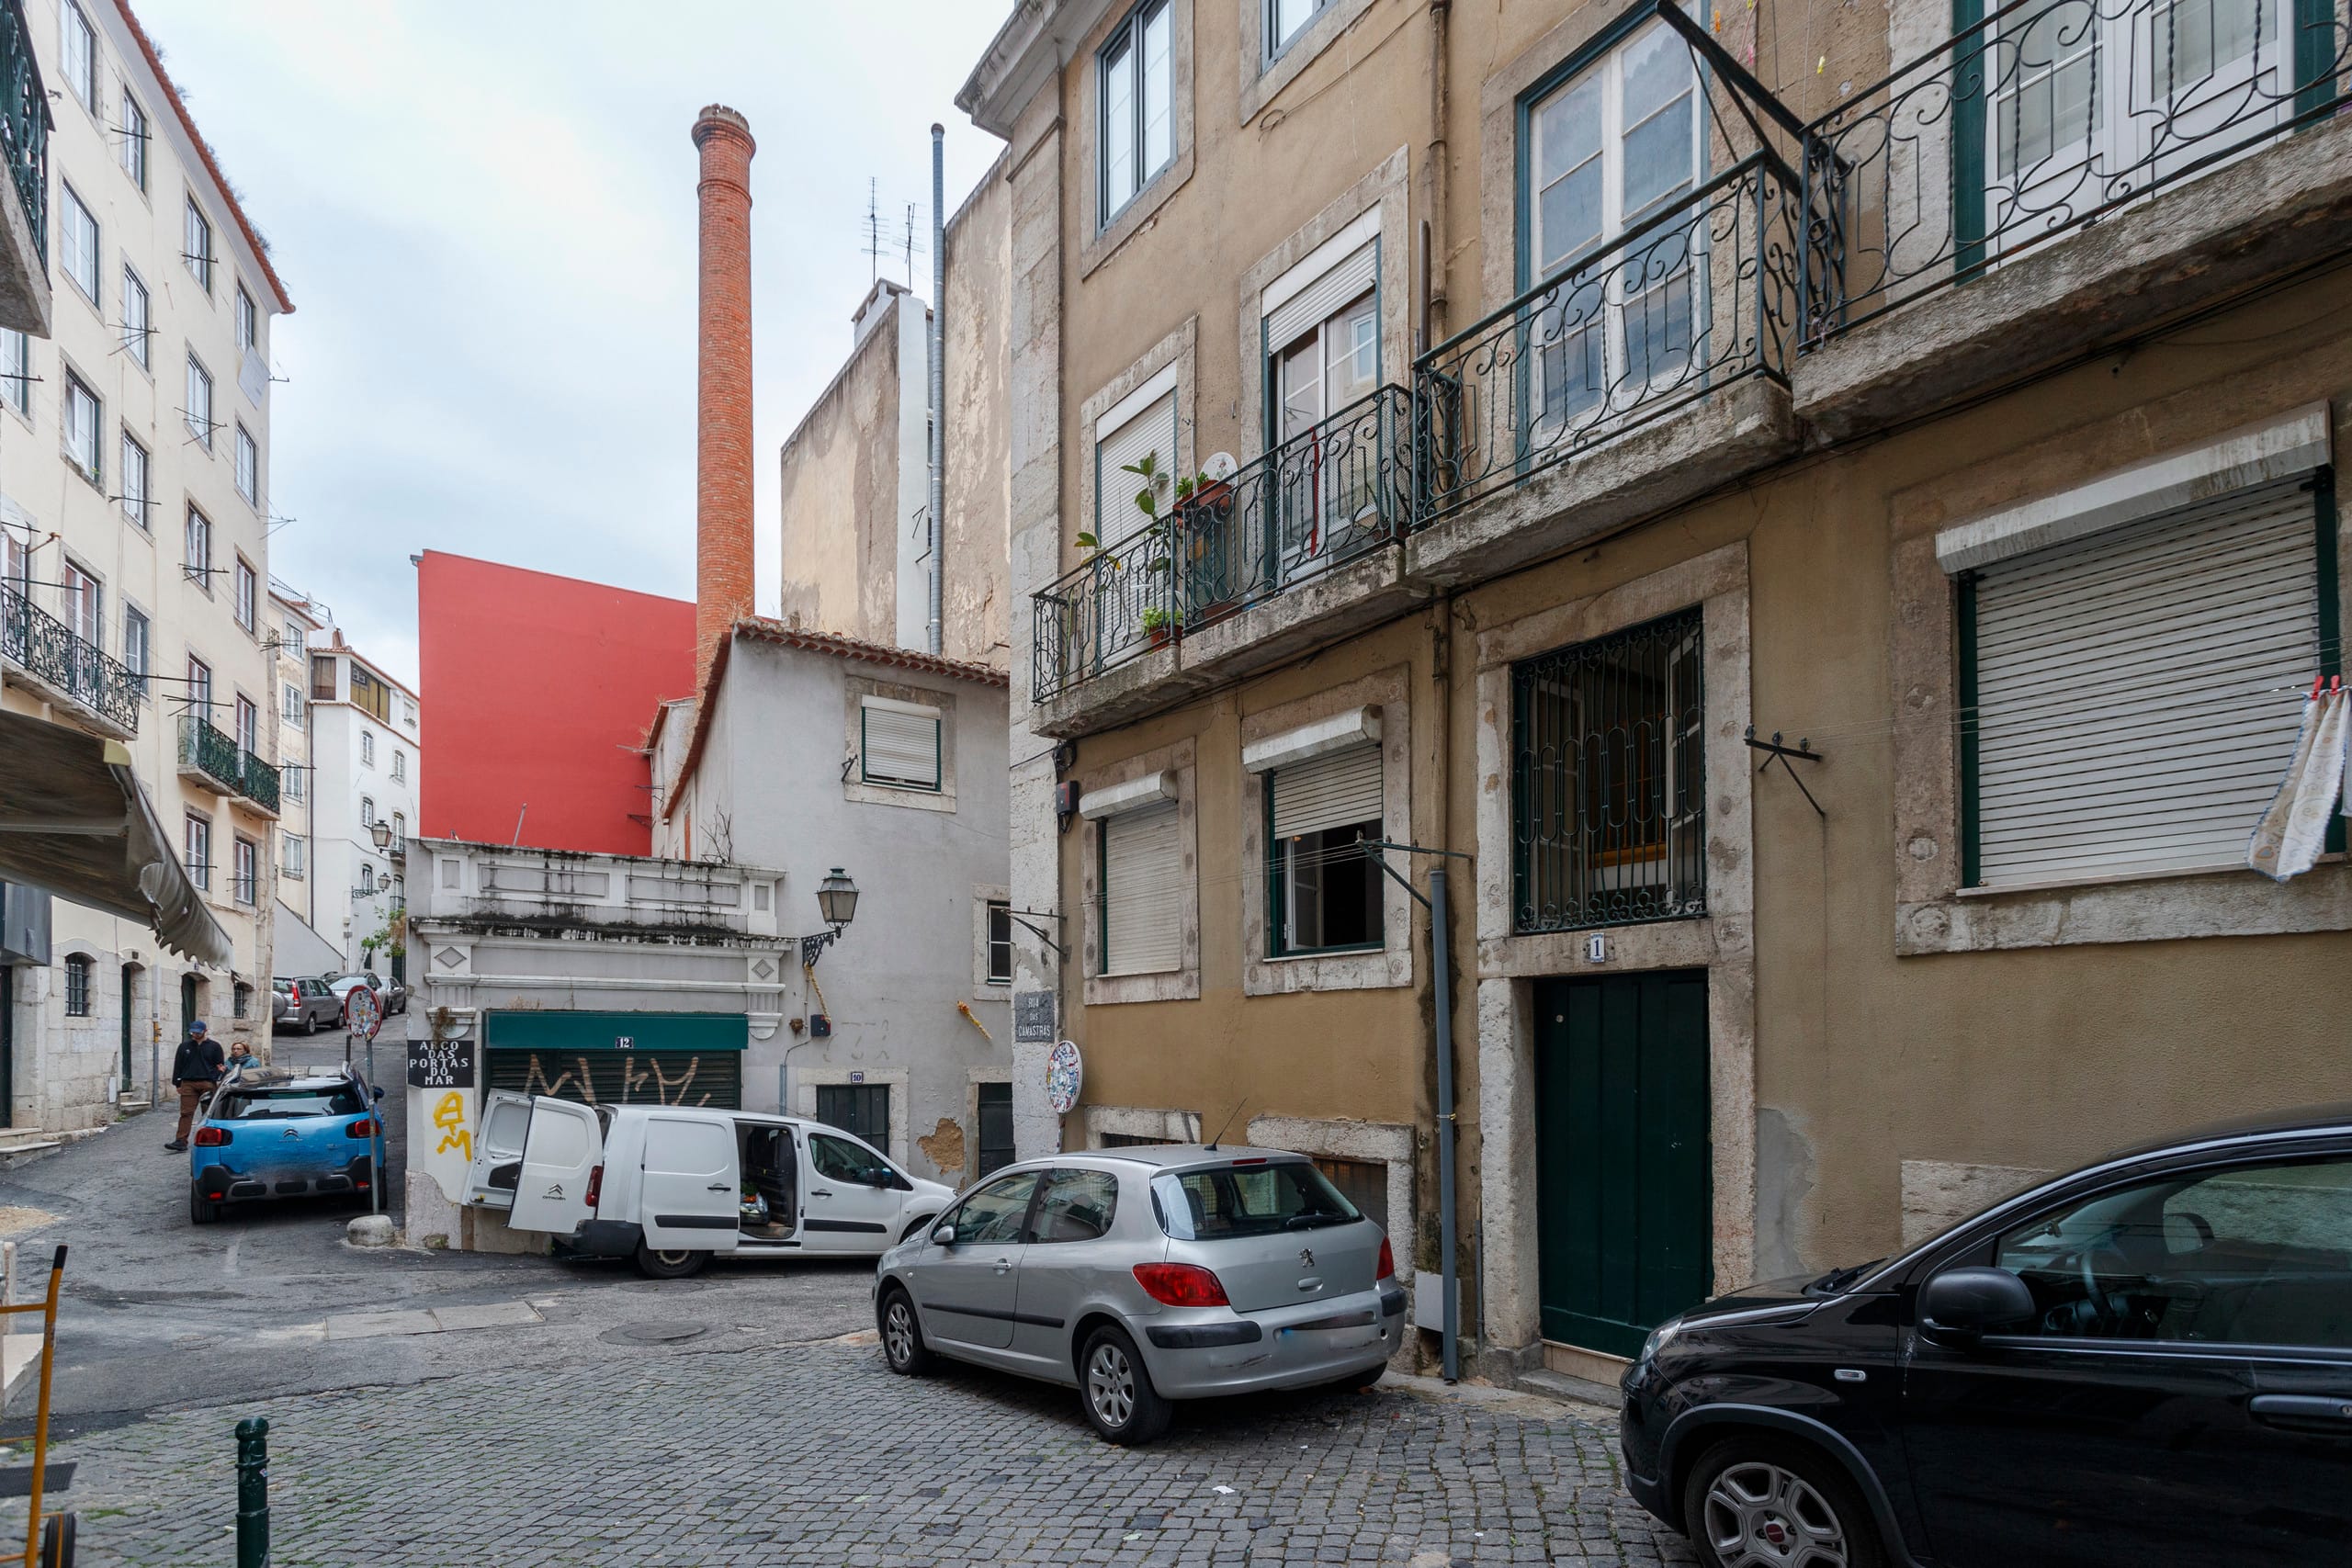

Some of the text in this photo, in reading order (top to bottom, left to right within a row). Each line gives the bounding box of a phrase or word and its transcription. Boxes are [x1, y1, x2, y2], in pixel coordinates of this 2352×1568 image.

[1594, 939, 1600, 957] 1
[1029, 1012, 1038, 1021] DAS
[1018, 1024, 1051, 1037] CANASTRAS
[419, 1041, 459, 1051] ARCO
[619, 1037, 630, 1048] 12
[428, 1050, 456, 1059] DAS
[409, 1057, 469, 1068] PORTAS
[430, 1066, 448, 1077] DO
[424, 1076, 454, 1086] MAR
[853, 1074, 862, 1082] 10
